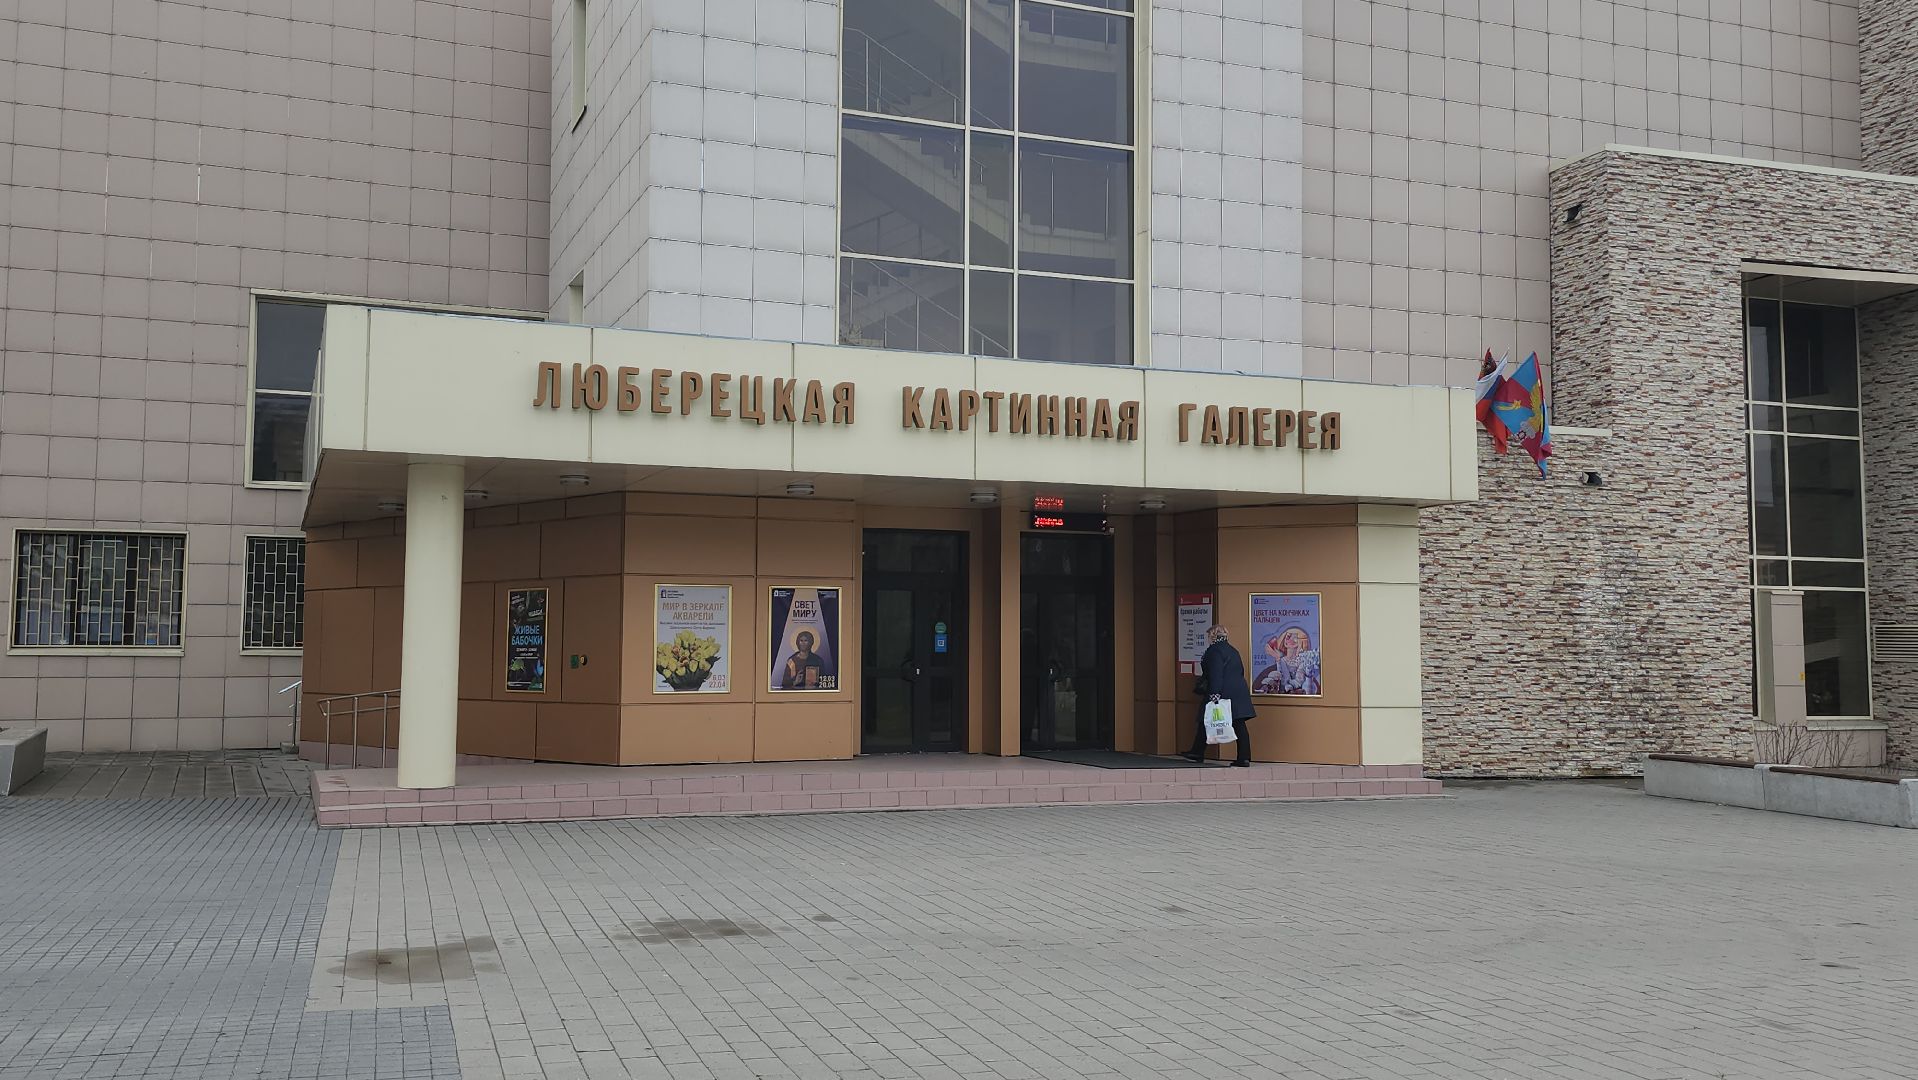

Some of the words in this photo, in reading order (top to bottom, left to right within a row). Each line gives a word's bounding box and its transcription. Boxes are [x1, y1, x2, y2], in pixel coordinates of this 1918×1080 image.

[533, 362, 855, 425] ЛЮБЕРЕЦКАЯ
[902, 385, 1140, 441] КАРТИННАЯ
[1178, 402, 1341, 450] ГАЛЕРЕЯ
[662, 602, 680, 611] МИР
[682, 603, 688, 611] В
[689, 602, 725, 611] ЗЕРКАЛЕ
[794, 600, 816, 609] СВЕТ
[672, 611, 714, 621] АКВАРЕЛИ
[792, 609, 817, 618] МИРУ
[514, 625, 540, 635] ЖИВЫЕ
[511, 634, 544, 646] БАБОЧКИ
